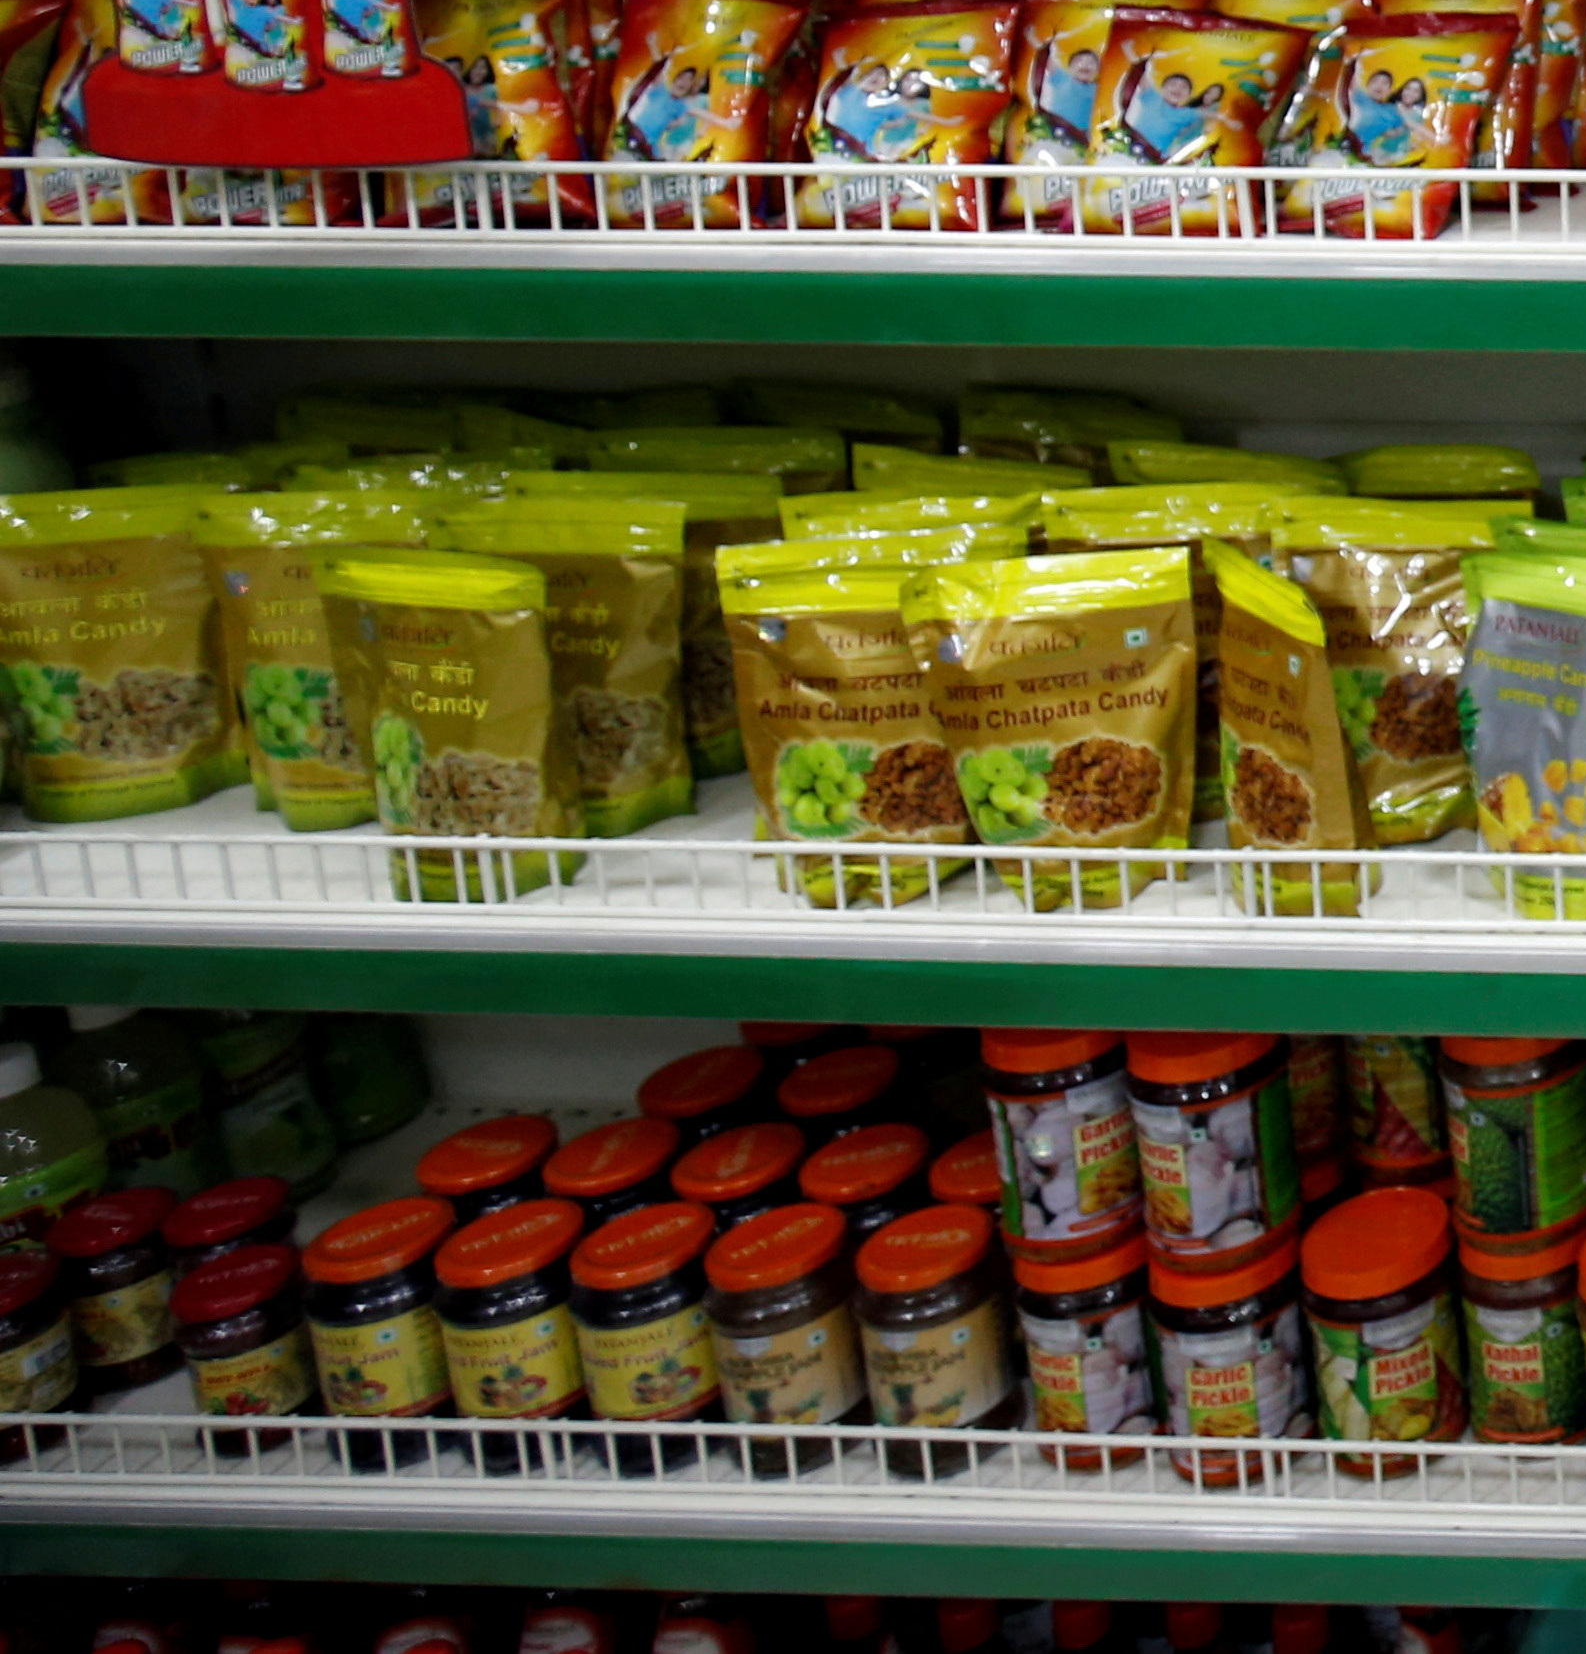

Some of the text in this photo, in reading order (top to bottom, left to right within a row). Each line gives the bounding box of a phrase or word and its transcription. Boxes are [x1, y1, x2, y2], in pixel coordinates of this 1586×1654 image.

[70, 615, 165, 643] Candy
[1495, 615, 1580, 644] PATANJALI
[410, 690, 488, 719] Candy
[760, 699, 919, 723] Amla Chatpata
[985, 685, 1168, 729] Chatpata Candy
[1374, 1351, 1431, 1378] Mixed
[1485, 1345, 1538, 1364] Kathal
[1188, 1366, 1246, 1388] Garlic
[1374, 1370, 1433, 1396] Pickle
[1486, 1364, 1540, 1383] Pickle
[1190, 1386, 1250, 1407] Pickle
